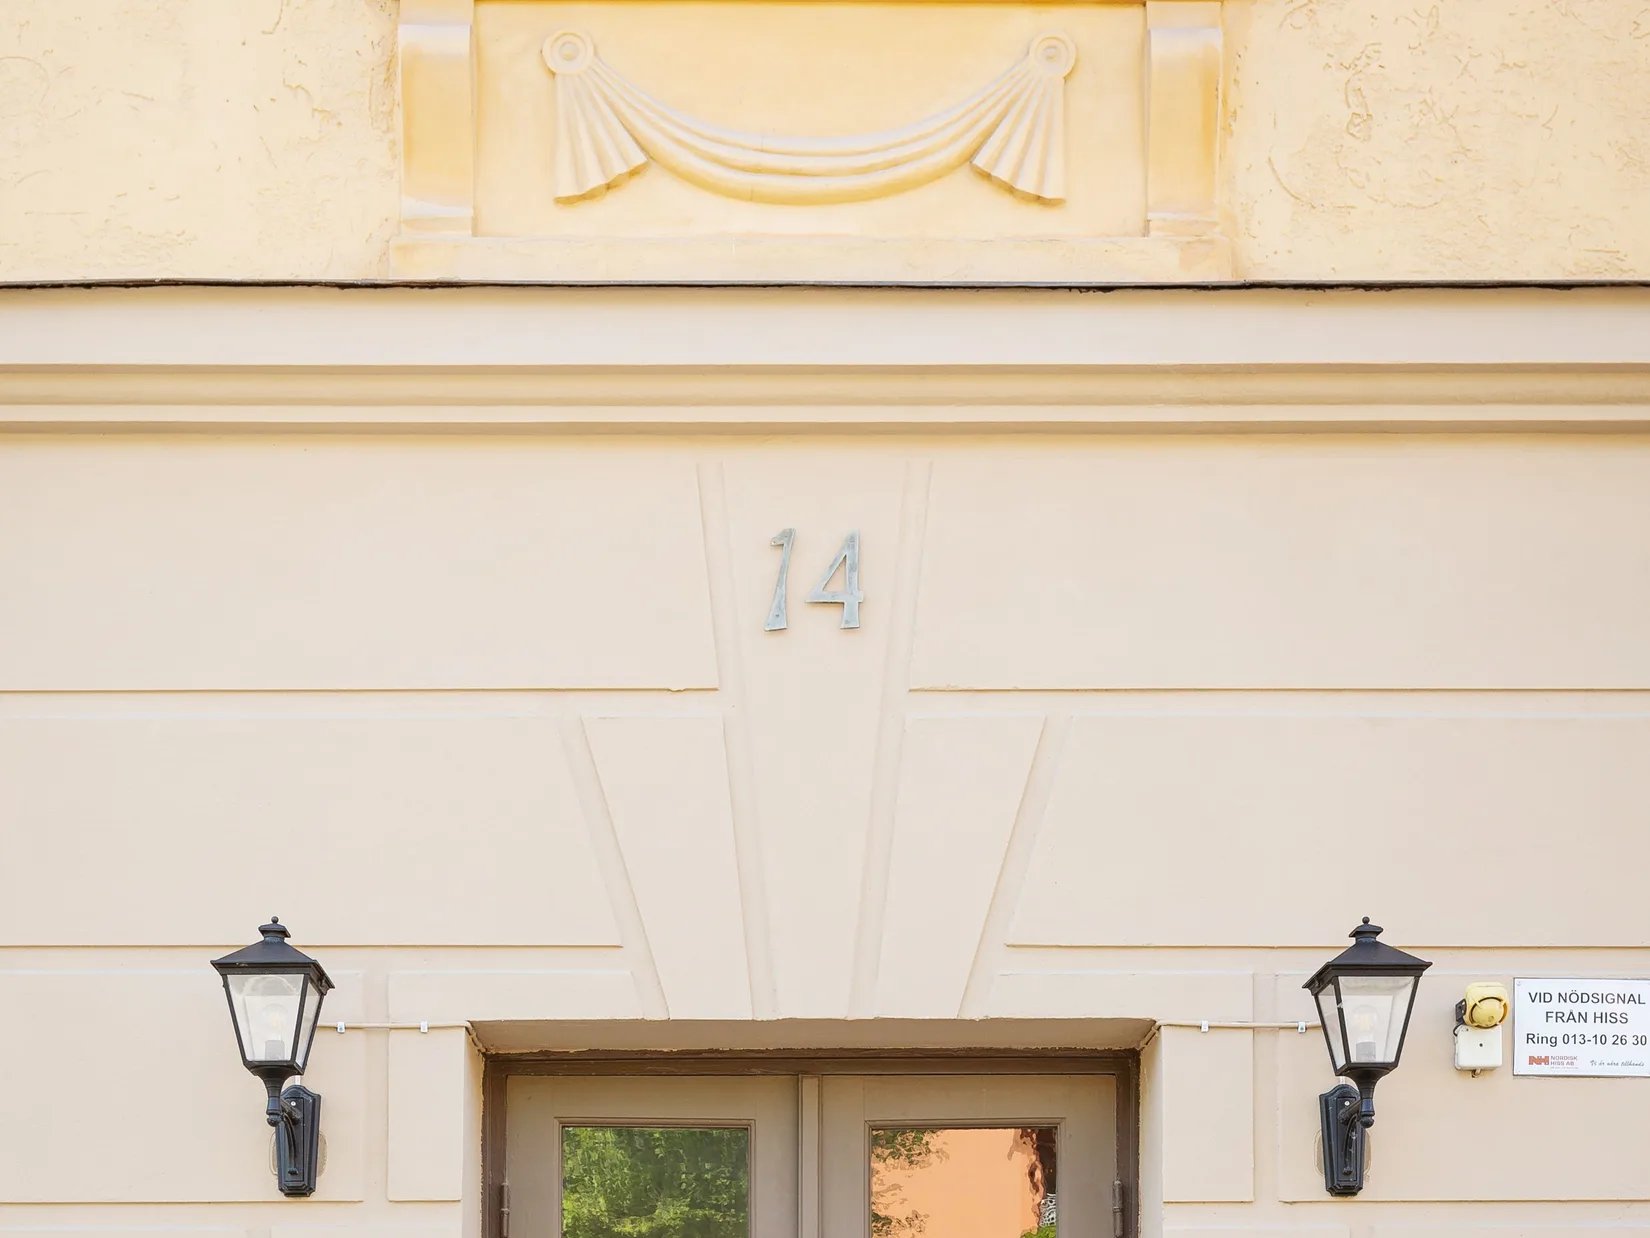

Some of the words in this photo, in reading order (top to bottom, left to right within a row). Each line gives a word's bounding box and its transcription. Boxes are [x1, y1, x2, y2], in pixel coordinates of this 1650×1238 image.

[764, 527, 864, 631] 14
[1528, 992, 1553, 1003] VID
[1558, 989, 1646, 1005] NÖDSIGNAL
[1545, 1009, 1588, 1023] FRÅN
[1593, 1012, 1629, 1024] HISS
[1526, 1033, 1558, 1047] Ring
[1562, 1033, 1607, 1046] 013-10
[1612, 1034, 1628, 1046] 26
[1632, 1034, 1647, 1046] 30
